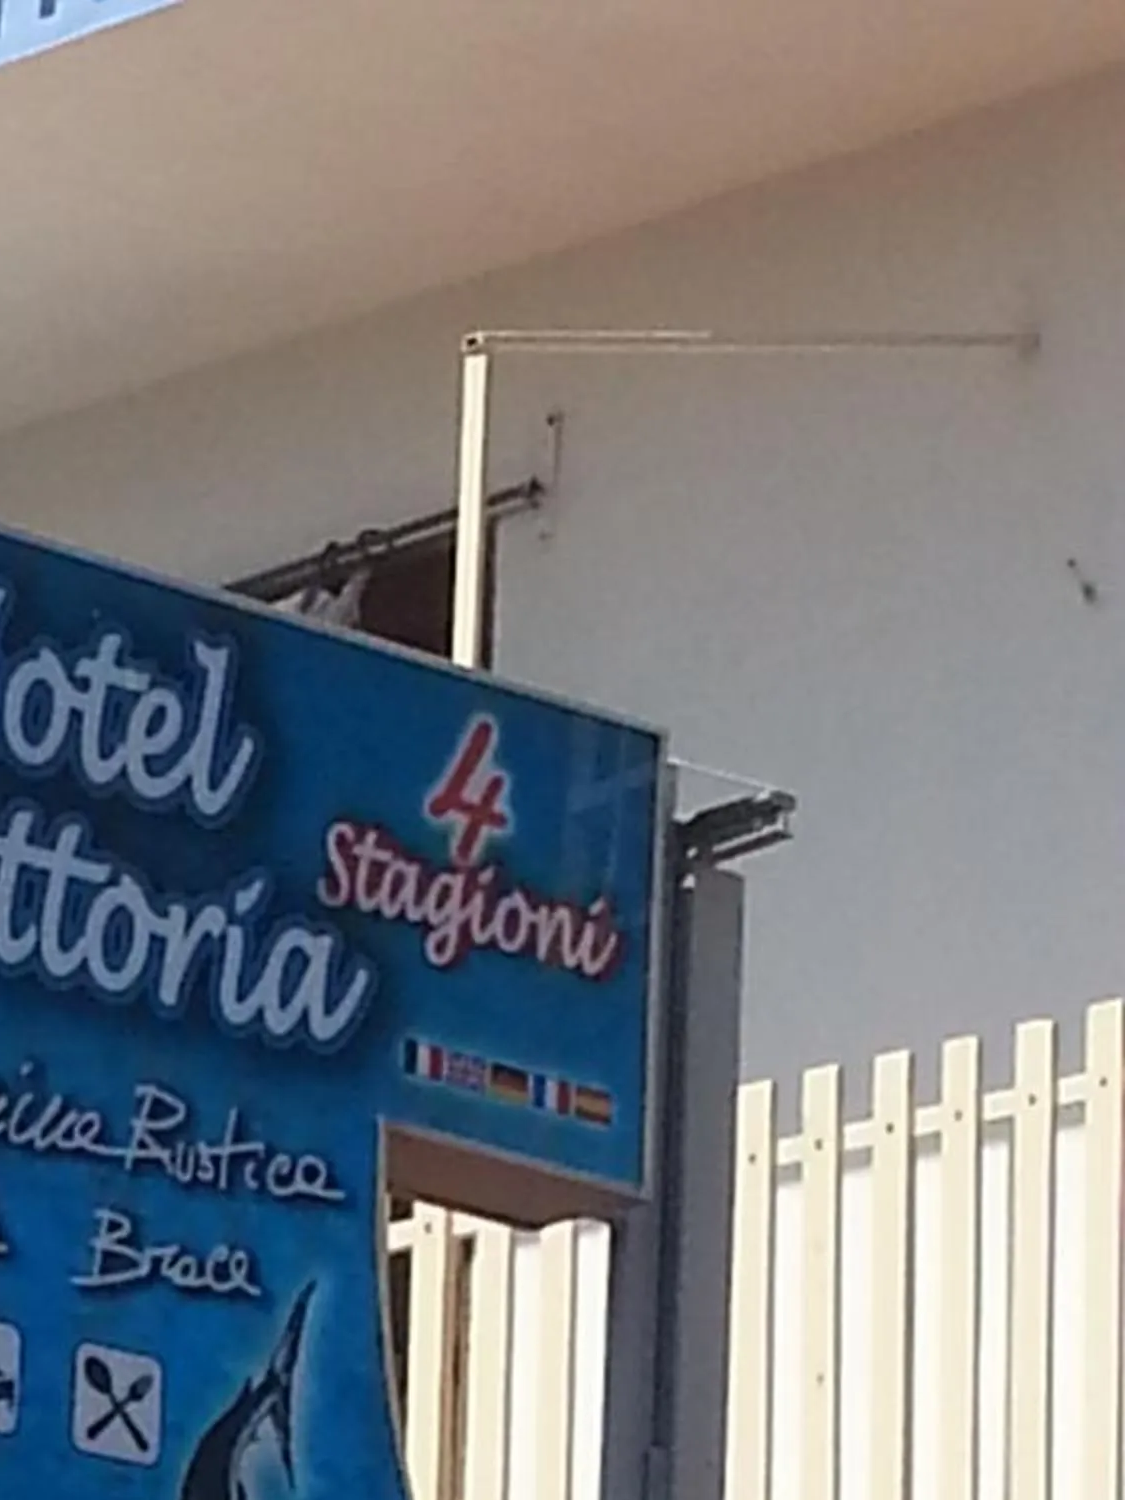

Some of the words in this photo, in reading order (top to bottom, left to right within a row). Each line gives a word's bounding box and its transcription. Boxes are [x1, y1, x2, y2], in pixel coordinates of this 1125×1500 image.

[425, 713, 512, 866] 4
[317, 822, 618, 976] Stagioni
[125, 1084, 345, 1200] Rustica
[71, 1209, 261, 1296] Brace
